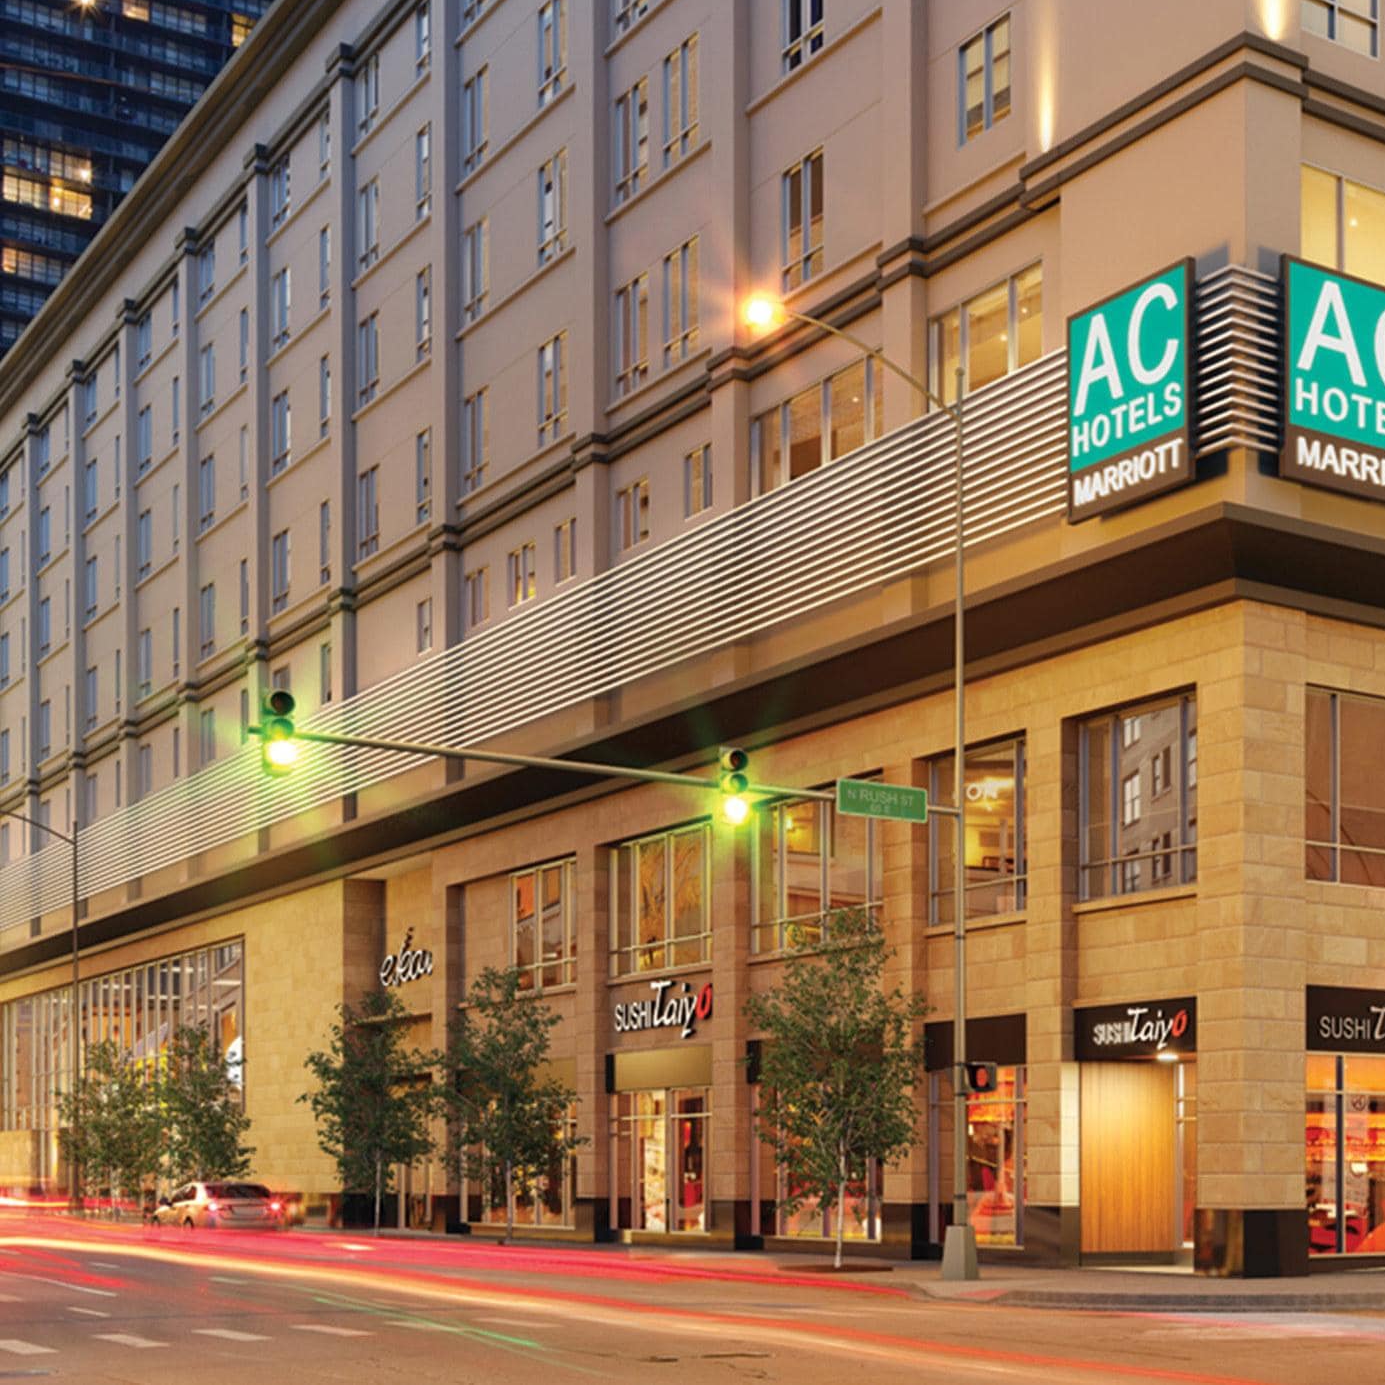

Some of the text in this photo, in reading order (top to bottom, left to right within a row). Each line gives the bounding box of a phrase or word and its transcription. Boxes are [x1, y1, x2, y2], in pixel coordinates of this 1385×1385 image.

[1073, 283, 1179, 416] AC
[1072, 382, 1182, 457] HOTELS
[1073, 438, 1183, 507] MARRIOTT
[859, 788, 898, 805] RUSH
[615, 981, 712, 1038] SUSHI Taiyo
[1093, 1008, 1187, 1050] SUSHI Taiyo
[1319, 1015, 1371, 1039] SUSHI
